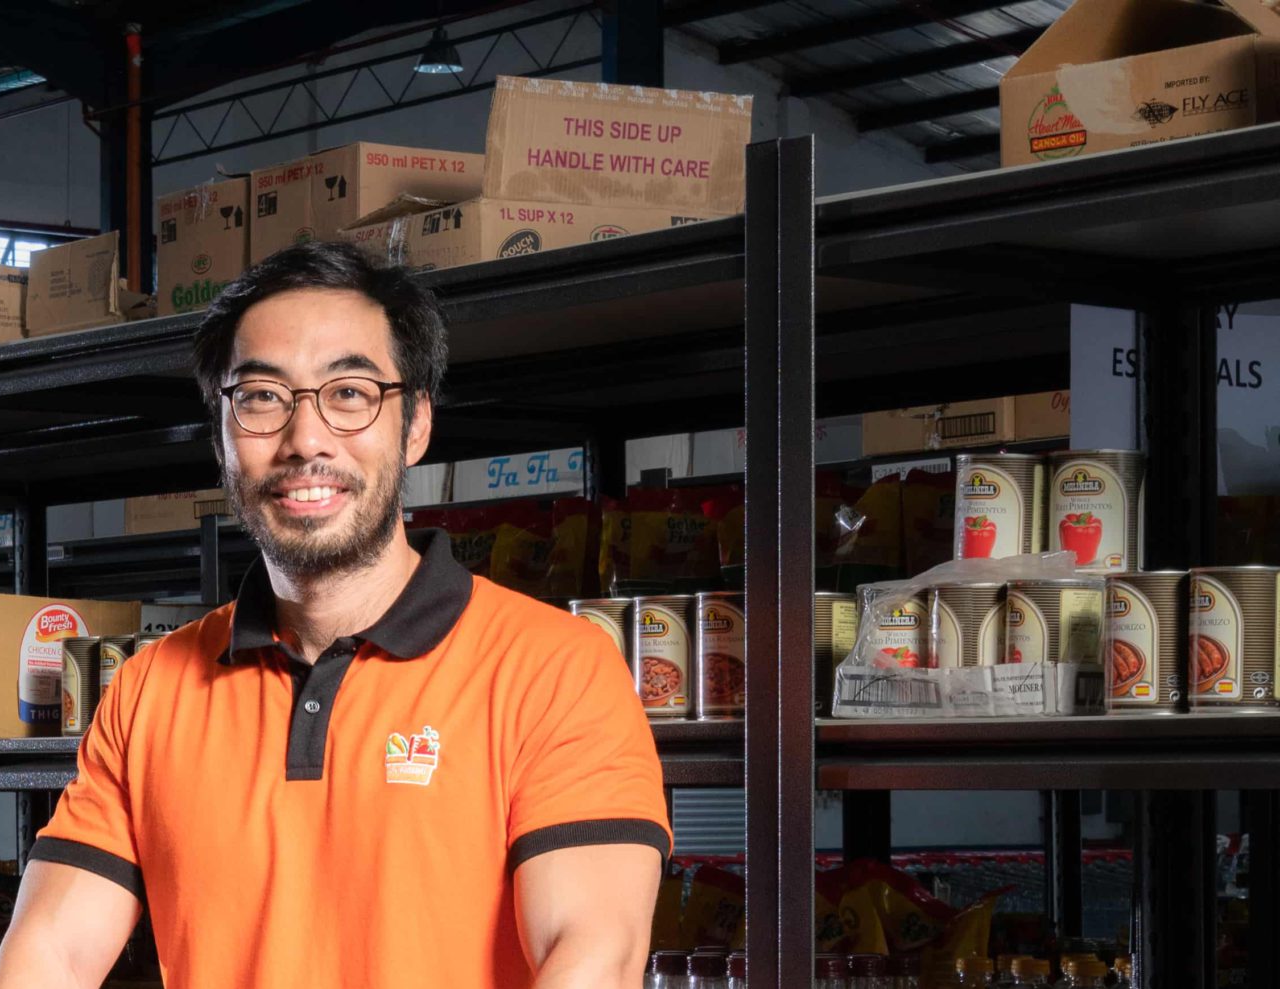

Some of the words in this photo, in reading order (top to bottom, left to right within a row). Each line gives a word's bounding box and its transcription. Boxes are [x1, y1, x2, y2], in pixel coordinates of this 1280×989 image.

[1165, 79, 1198, 89] IMPORTED
[1198, 76, 1211, 85] BY:
[1183, 95, 1210, 111] FLY
[1213, 89, 1248, 104] ACE
[564, 117, 605, 138] THIS
[610, 121, 652, 142] SIDE
[657, 124, 683, 144] UP
[1032, 134, 1068, 150] CANOLA
[1070, 132, 1086, 145] OIL
[366, 153, 389, 167] 950
[392, 155, 407, 168] ml
[411, 156, 437, 171] PET
[439, 159, 449, 172] X
[451, 160, 465, 173] 12
[528, 149, 605, 171] HANDLE
[609, 153, 655, 175] WITH
[661, 158, 710, 179] CARE
[258, 175, 273, 189] 950
[287, 168, 302, 182] PET
[314, 163, 324, 174] 12
[500, 207, 515, 221] 1L
[518, 208, 545, 223] SUP
[547, 210, 557, 224] X
[560, 212, 575, 225] 12
[172, 277, 230, 308] Golde
[1063, 481, 1100, 492] MOLINERA
[1069, 502, 1113, 512] PIMIENTOS
[40, 613, 70, 629] Bounty
[48, 620, 73, 633] fresh
[27, 645, 57, 656] CHICKEN
[1008, 682, 1043, 694] MOLINERA
[30, 708, 59, 720] THIG
